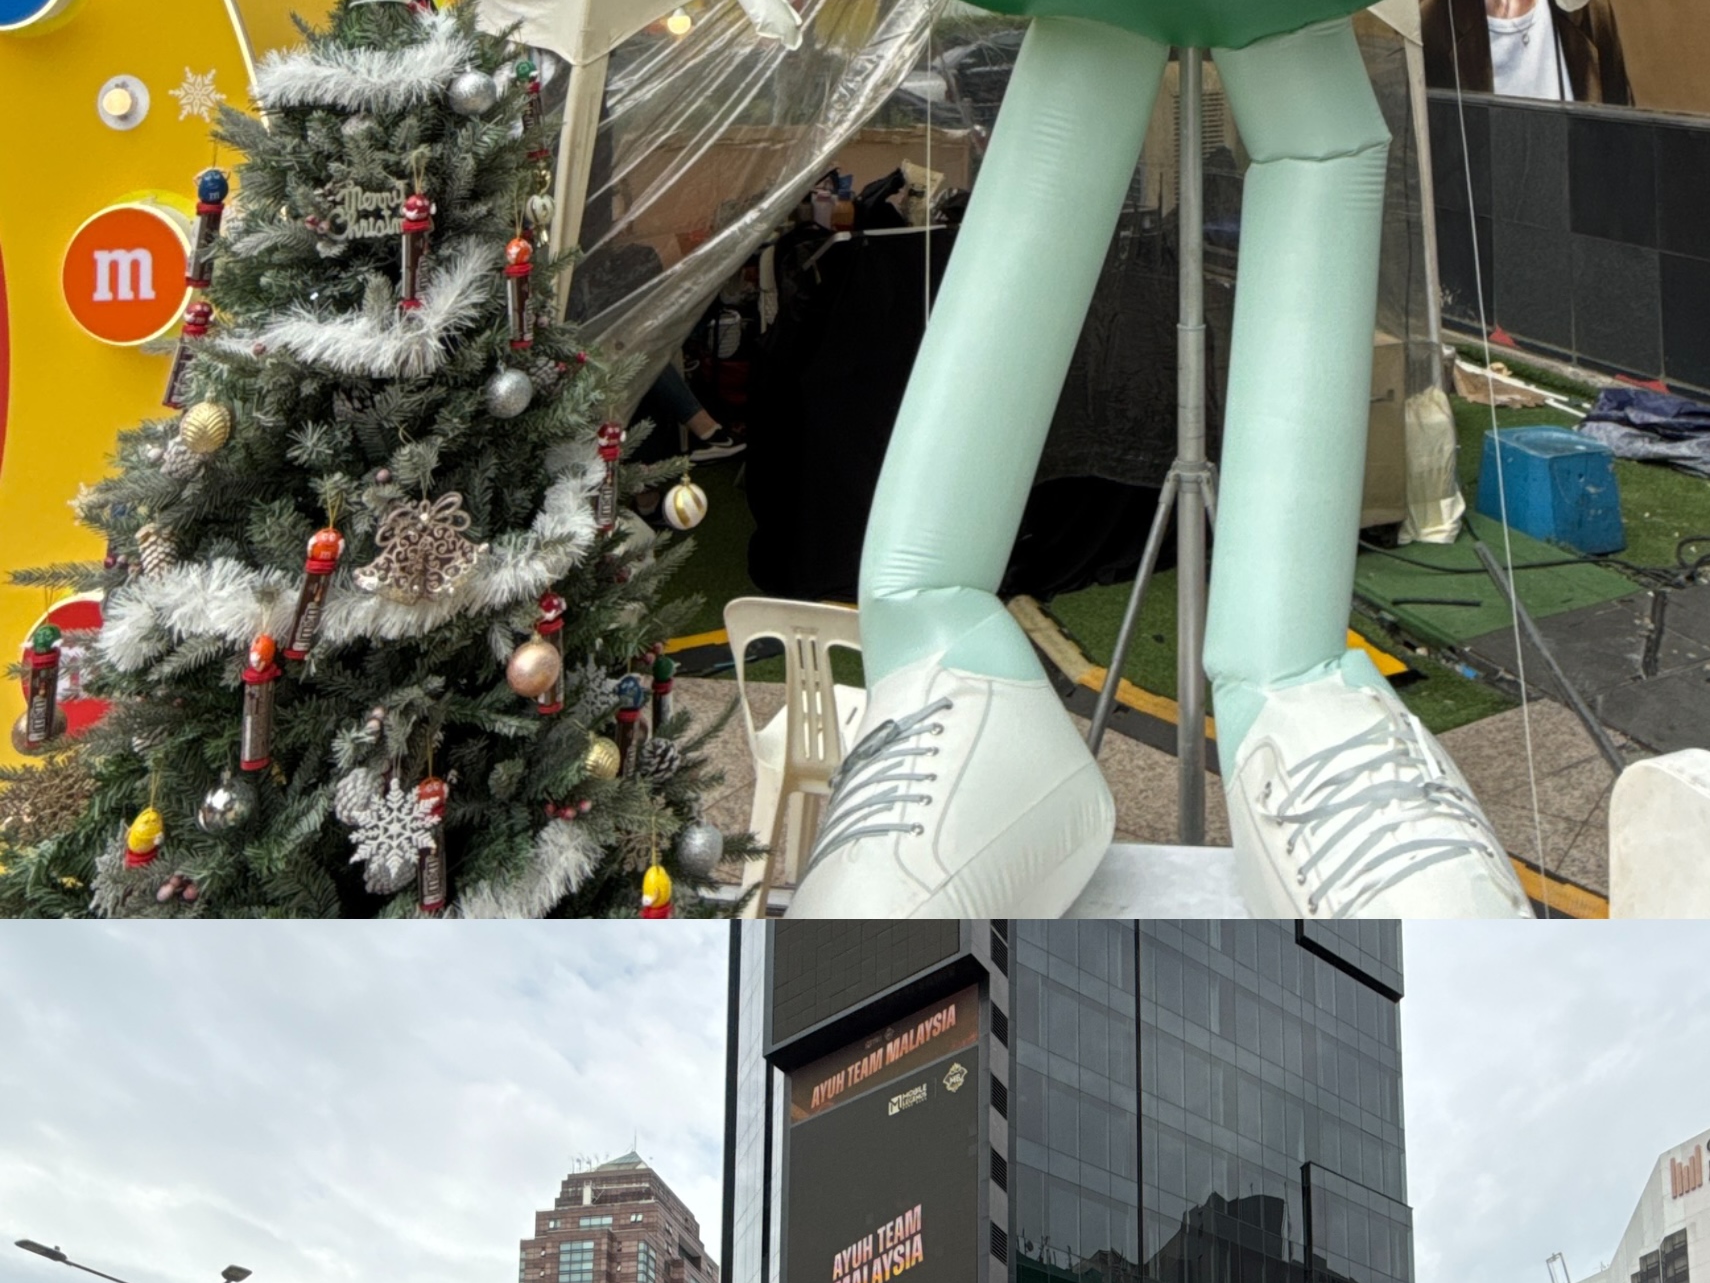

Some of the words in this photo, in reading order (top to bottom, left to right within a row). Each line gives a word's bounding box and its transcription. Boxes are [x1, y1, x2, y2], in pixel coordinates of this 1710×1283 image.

[94, 249, 155, 301] m
[811, 1072, 846, 1109] AYUH
[847, 1047, 883, 1088] TEAM
[886, 1004, 957, 1066] MALAYSIA
[833, 1234, 873, 1281] AYUH
[877, 1204, 922, 1252] TEAM
